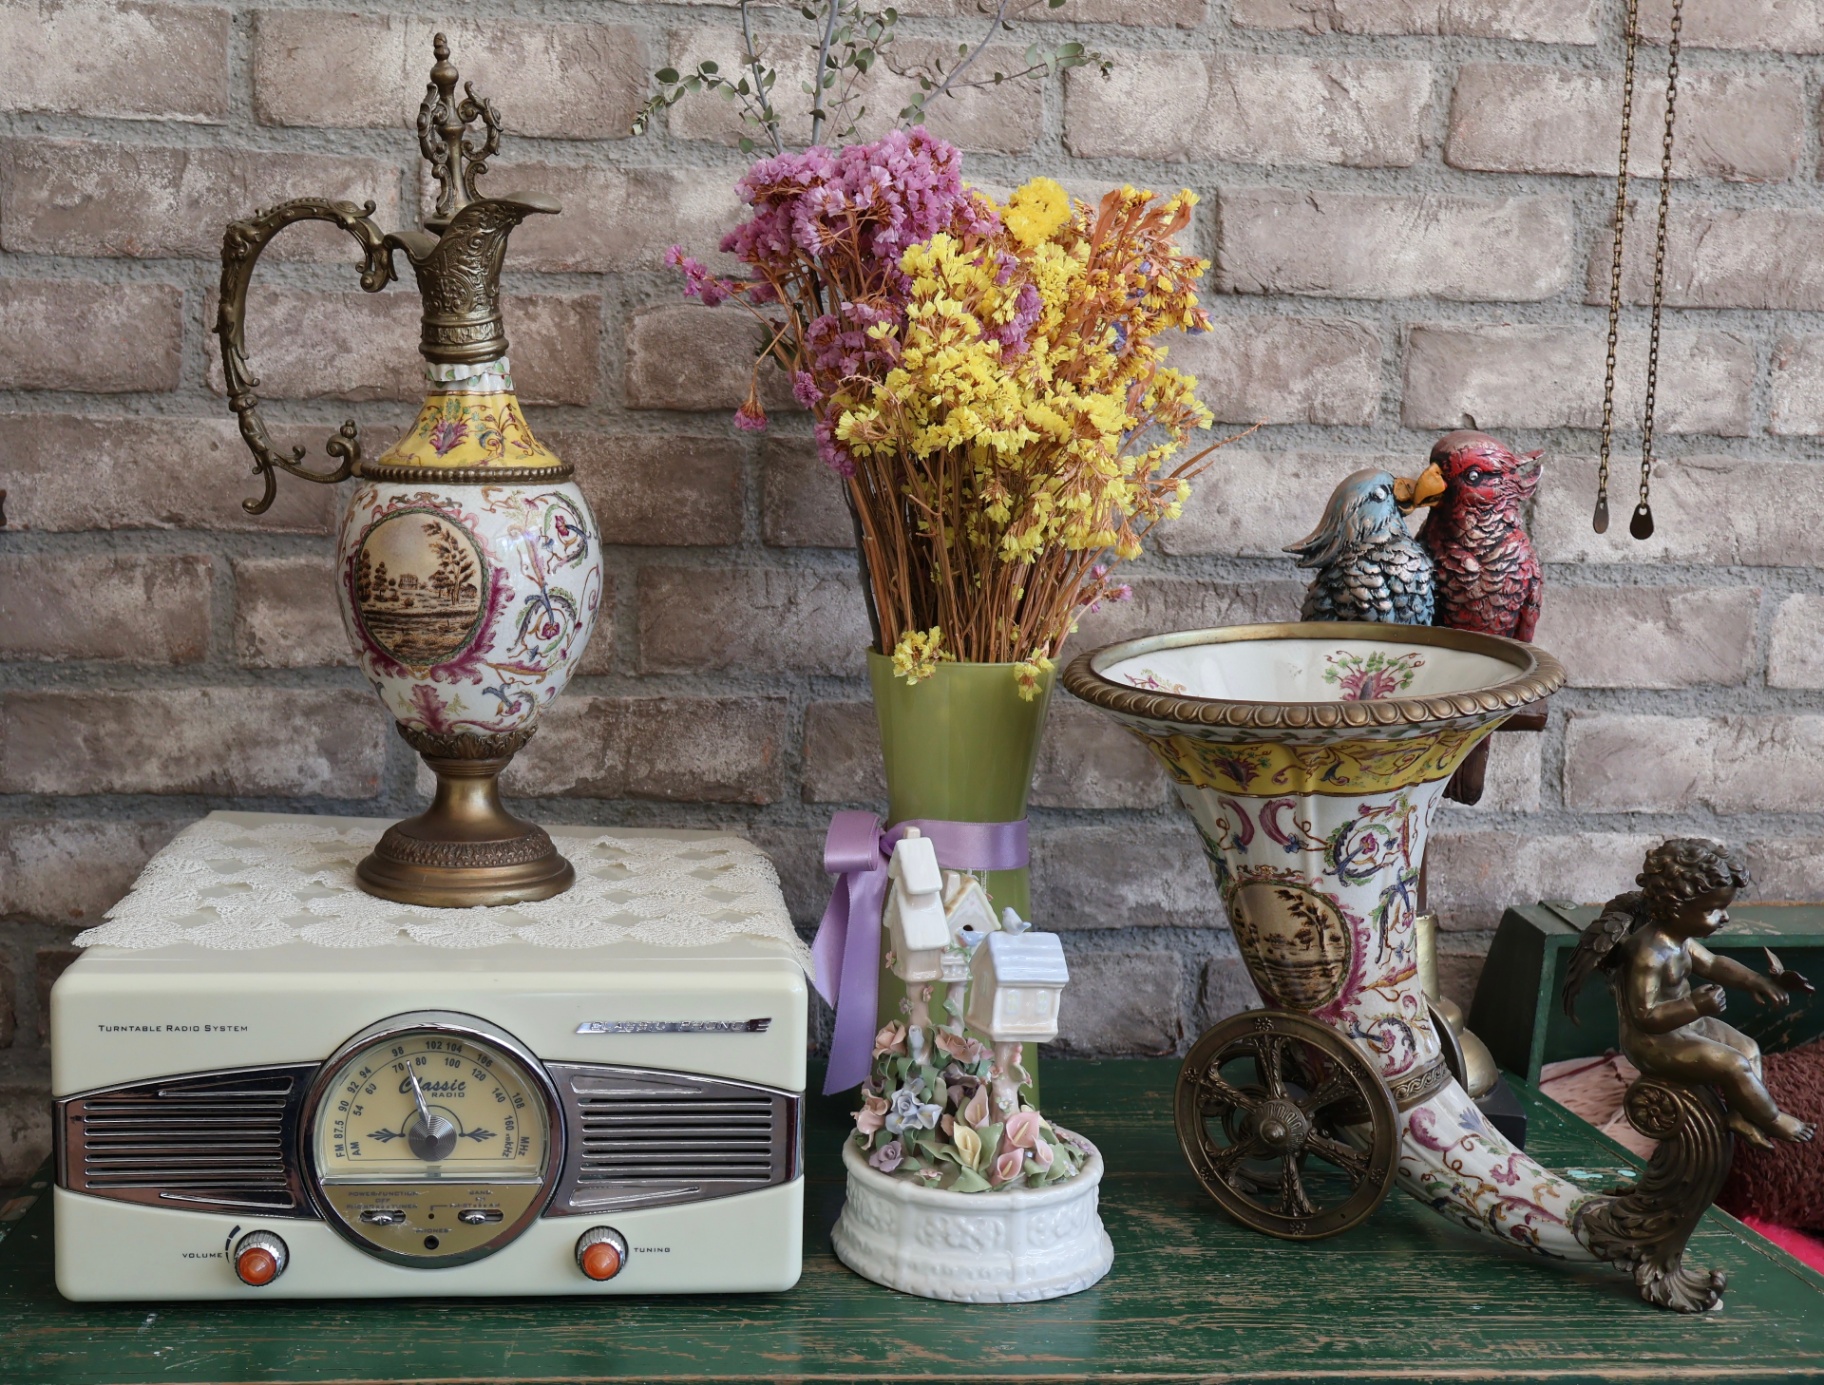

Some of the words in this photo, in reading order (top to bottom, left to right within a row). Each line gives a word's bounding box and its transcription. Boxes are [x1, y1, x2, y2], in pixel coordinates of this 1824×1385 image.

[426, 1040, 442, 1050] 102
[446, 1041, 463, 1053] 104
[391, 1046, 405, 1058] 98
[415, 1056, 427, 1066] 80
[444, 1057, 461, 1069] 100
[477, 1053, 494, 1068] 106
[359, 1066, 372, 1079] 94
[392, 1062, 405, 1074] 70
[471, 1068, 487, 1082] 120
[346, 1081, 360, 1094] 92
[364, 1083, 378, 1096] 60
[399, 1076, 467, 1095] Classic
[431, 1091, 466, 1099] RADIO
[492, 1087, 506, 1104] 140
[512, 1092, 526, 1110] 108
[337, 1100, 350, 1113] 90
[352, 1104, 364, 1117] 54
[333, 1119, 345, 1139] 87.5
[504, 1115, 515, 1132] 160
[334, 1143, 346, 1158] FM
[349, 1141, 362, 1157] AM
[517, 1136, 530, 1157] MHz
